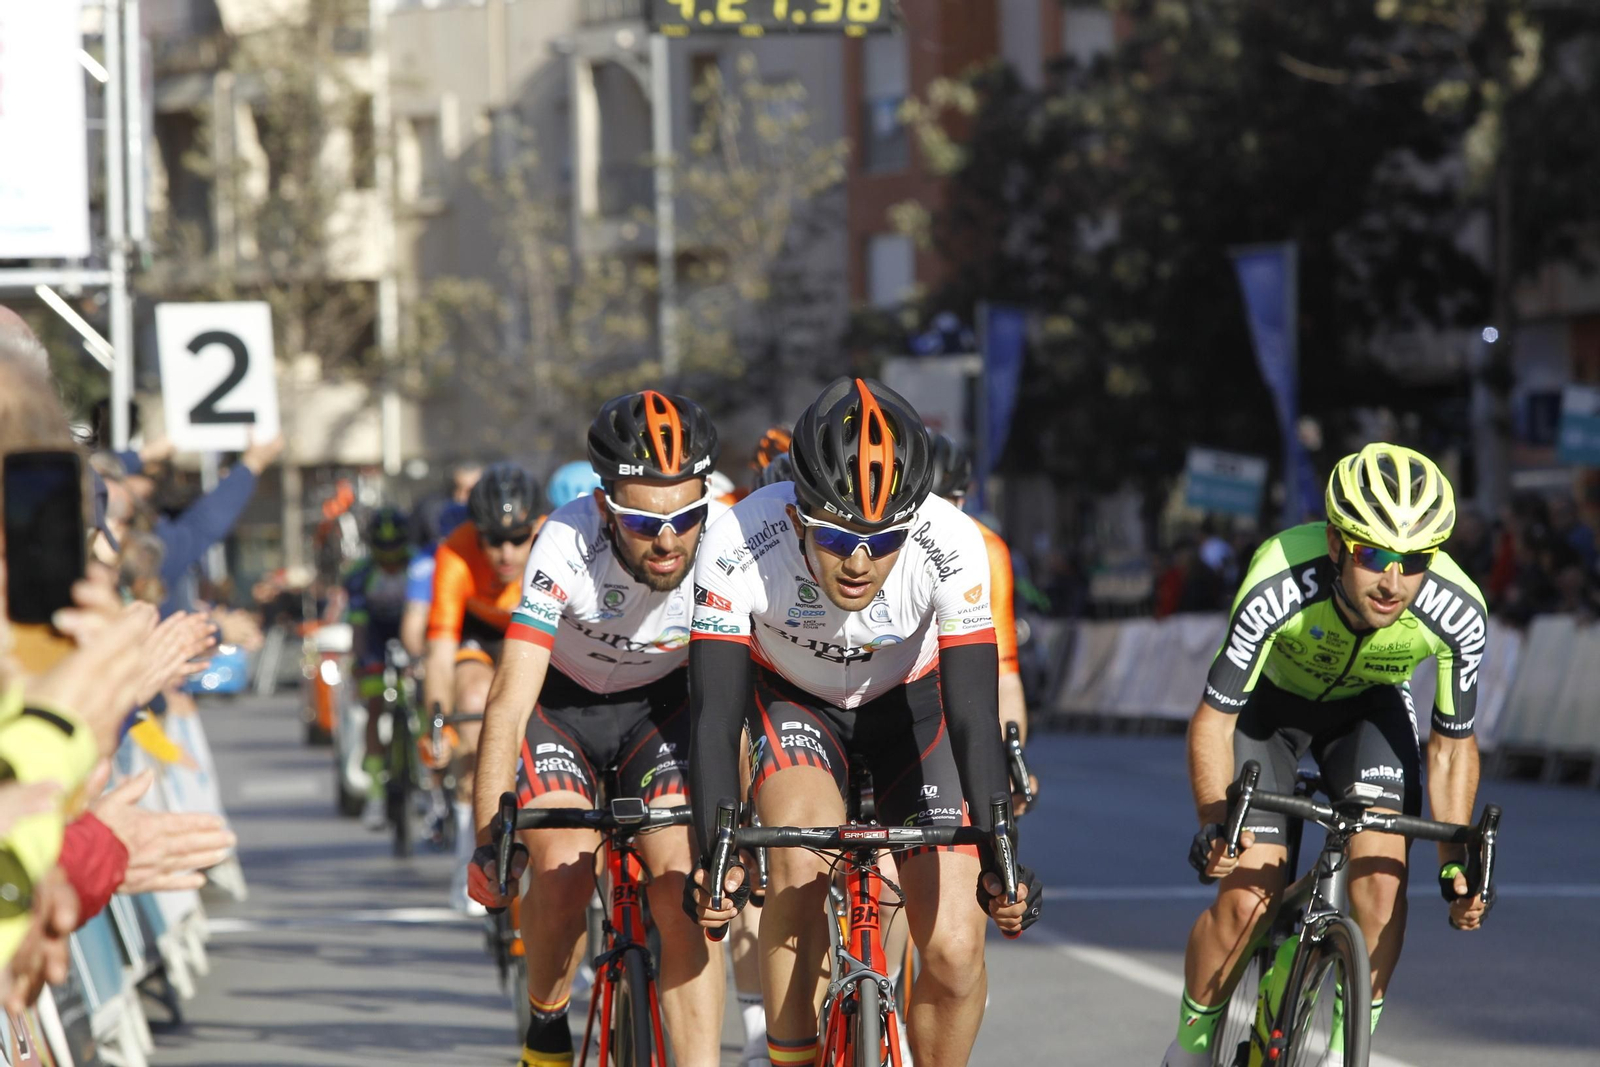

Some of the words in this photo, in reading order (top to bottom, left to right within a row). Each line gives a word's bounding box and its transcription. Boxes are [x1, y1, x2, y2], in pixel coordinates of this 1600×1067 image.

[185, 329, 256, 425] 2
[619, 463, 644, 476] BH
[824, 501, 853, 521] BH
[911, 521, 963, 582] Burpellet
[1225, 567, 1319, 671] MURIAS
[1414, 578, 1486, 692] MURIAS
[781, 721, 821, 739] BH
[535, 742, 574, 759] BH
[1361, 765, 1403, 779] kalas
[918, 808, 963, 818] GOPASA
[613, 885, 639, 898] BH
[851, 904, 880, 925] BH
